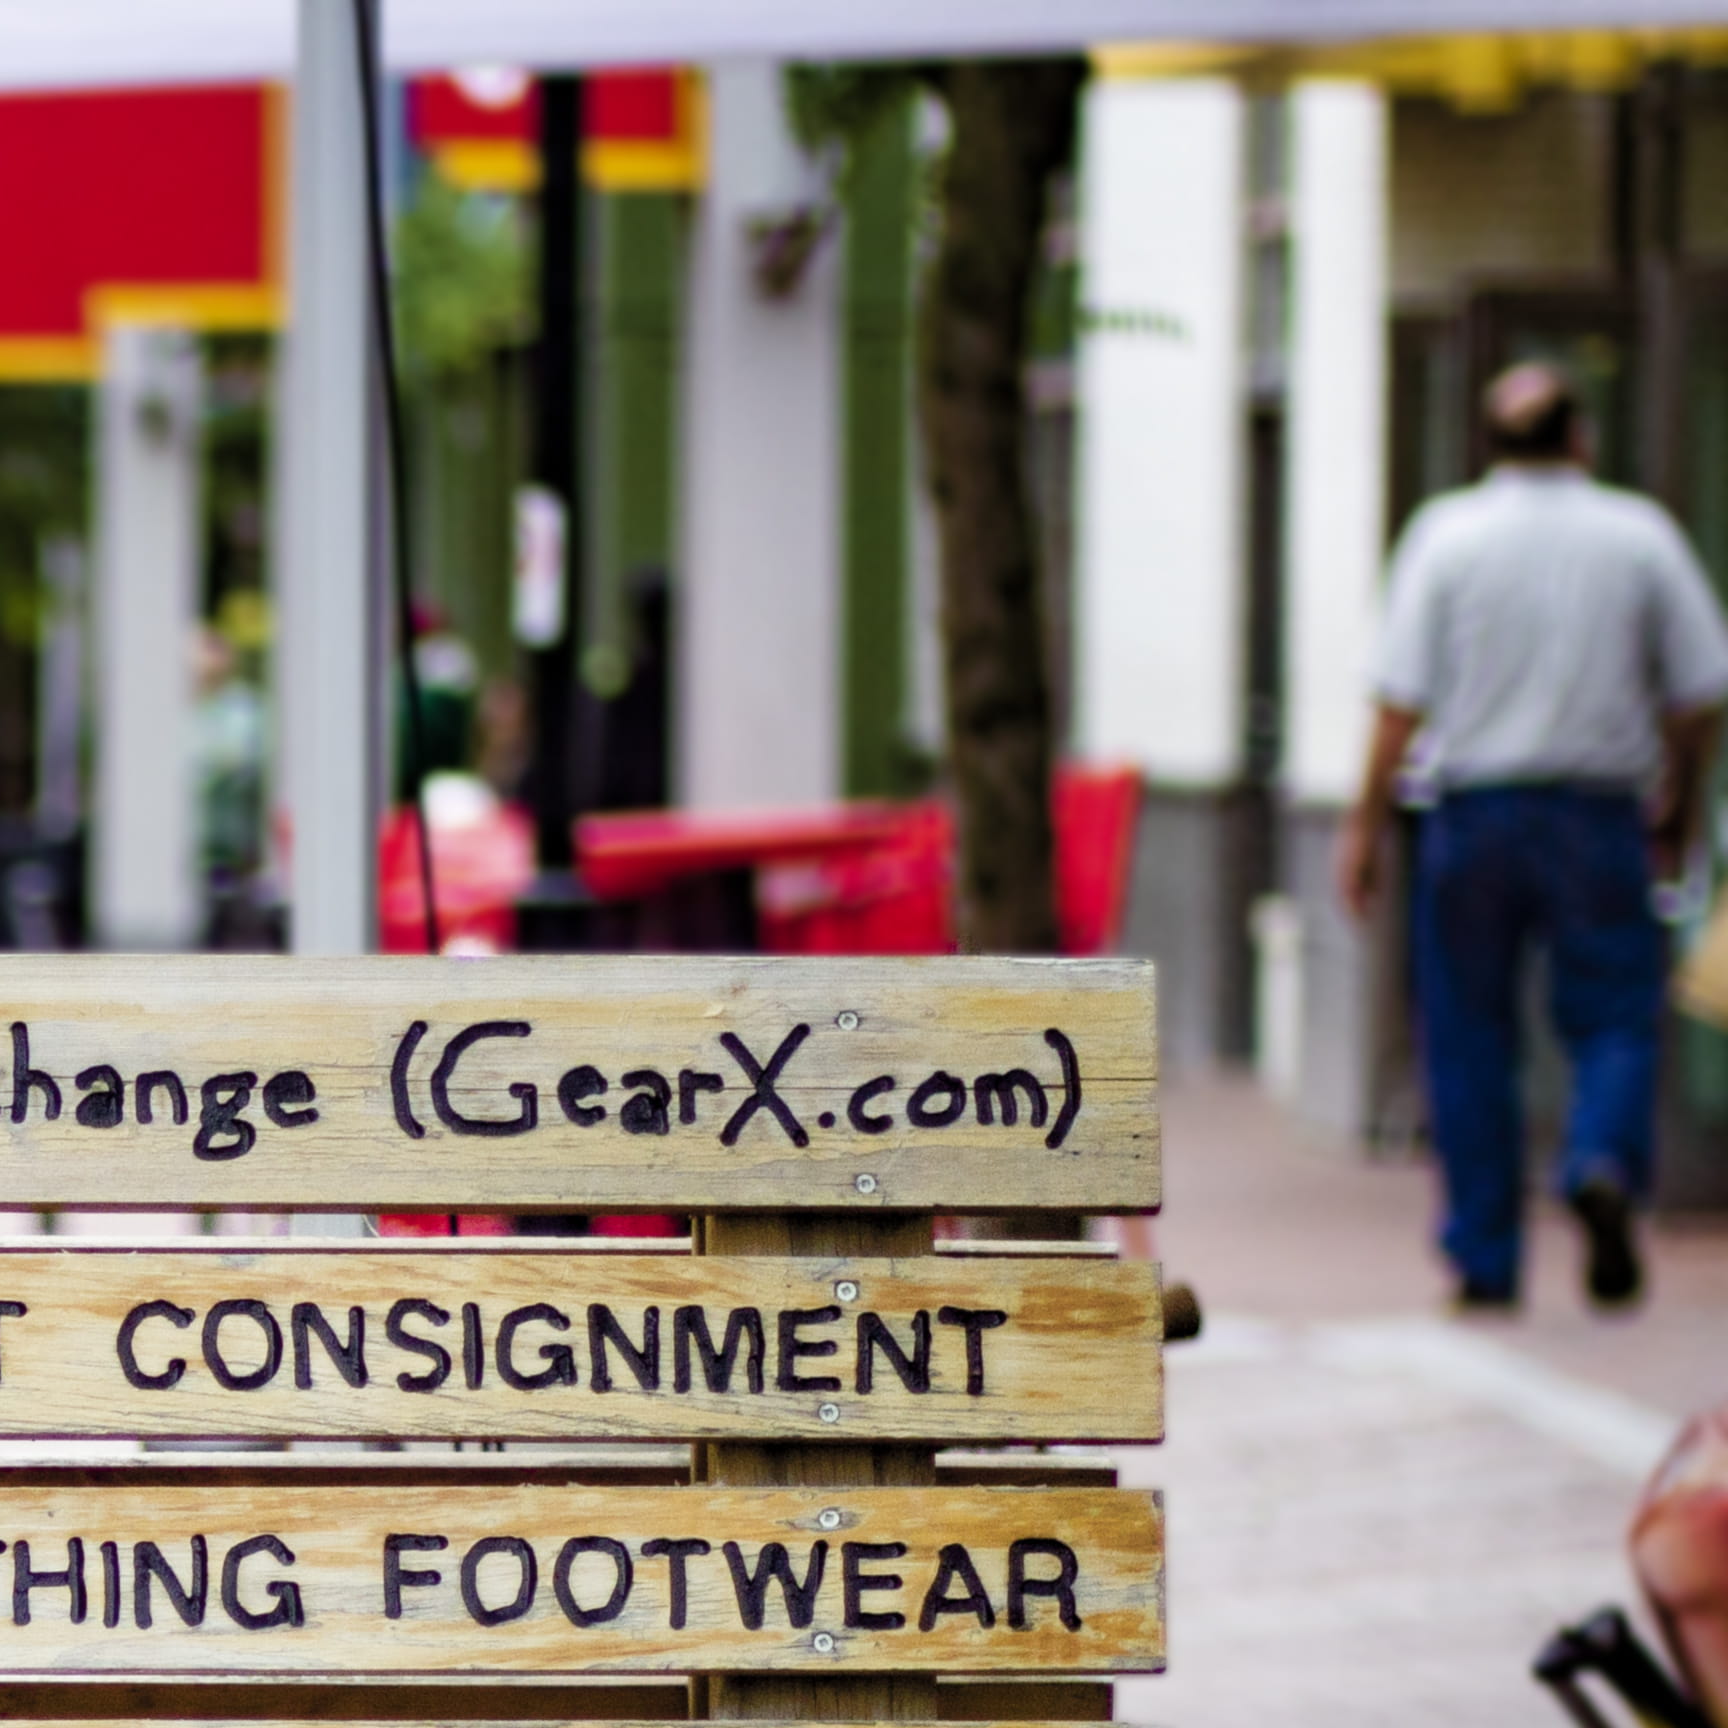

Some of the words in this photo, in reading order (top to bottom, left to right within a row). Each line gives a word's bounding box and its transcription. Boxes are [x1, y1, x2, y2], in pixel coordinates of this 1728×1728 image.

[390, 1021, 1085, 1149] (GearX.com)
[117, 1298, 1010, 1397] CONSIGNMENT
[384, 1534, 1083, 1632] FOOTWEAR
